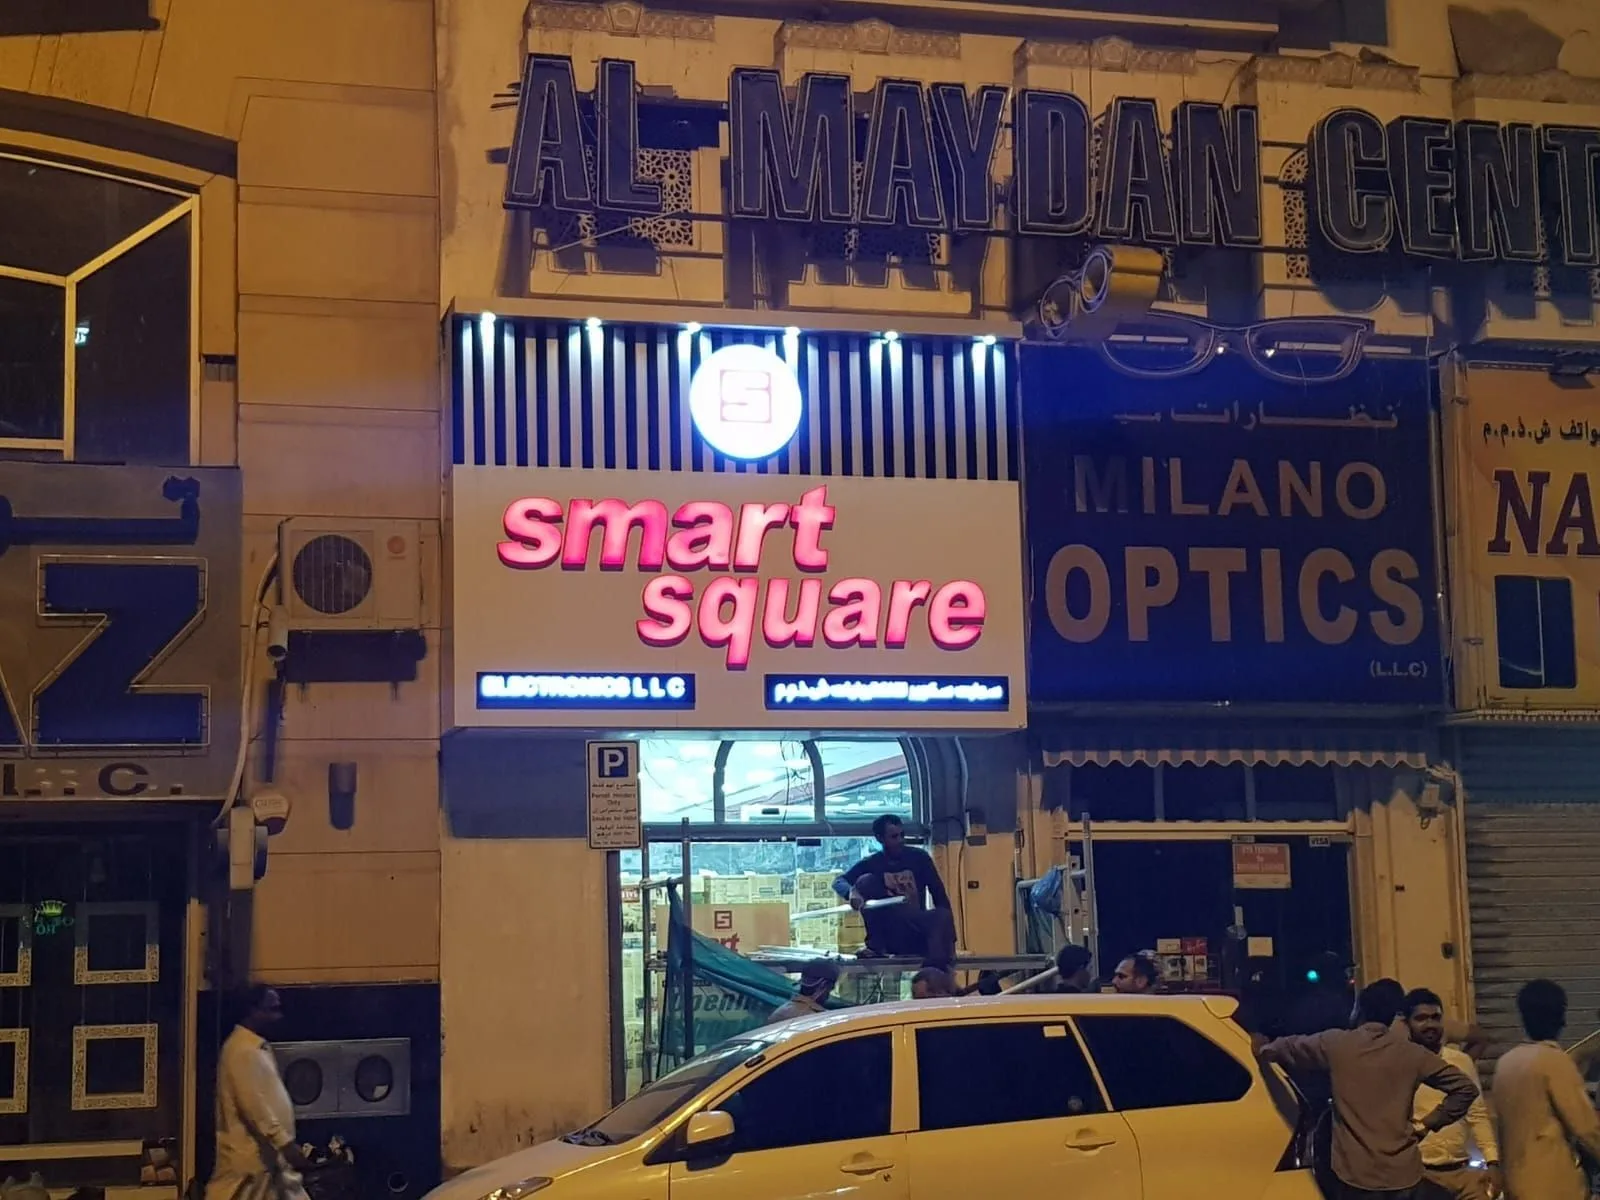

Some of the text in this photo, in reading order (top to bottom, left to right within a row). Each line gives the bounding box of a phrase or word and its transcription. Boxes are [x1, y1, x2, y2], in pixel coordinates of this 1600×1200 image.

[503, 54, 1600, 268] AL MAYDAN CENT
[497, 484, 836, 572] smart
[1074, 454, 1387, 520] MILANO
[1487, 468, 1600, 556] NA
[636, 574, 987, 671] square
[1045, 543, 1424, 646] OPTICS
